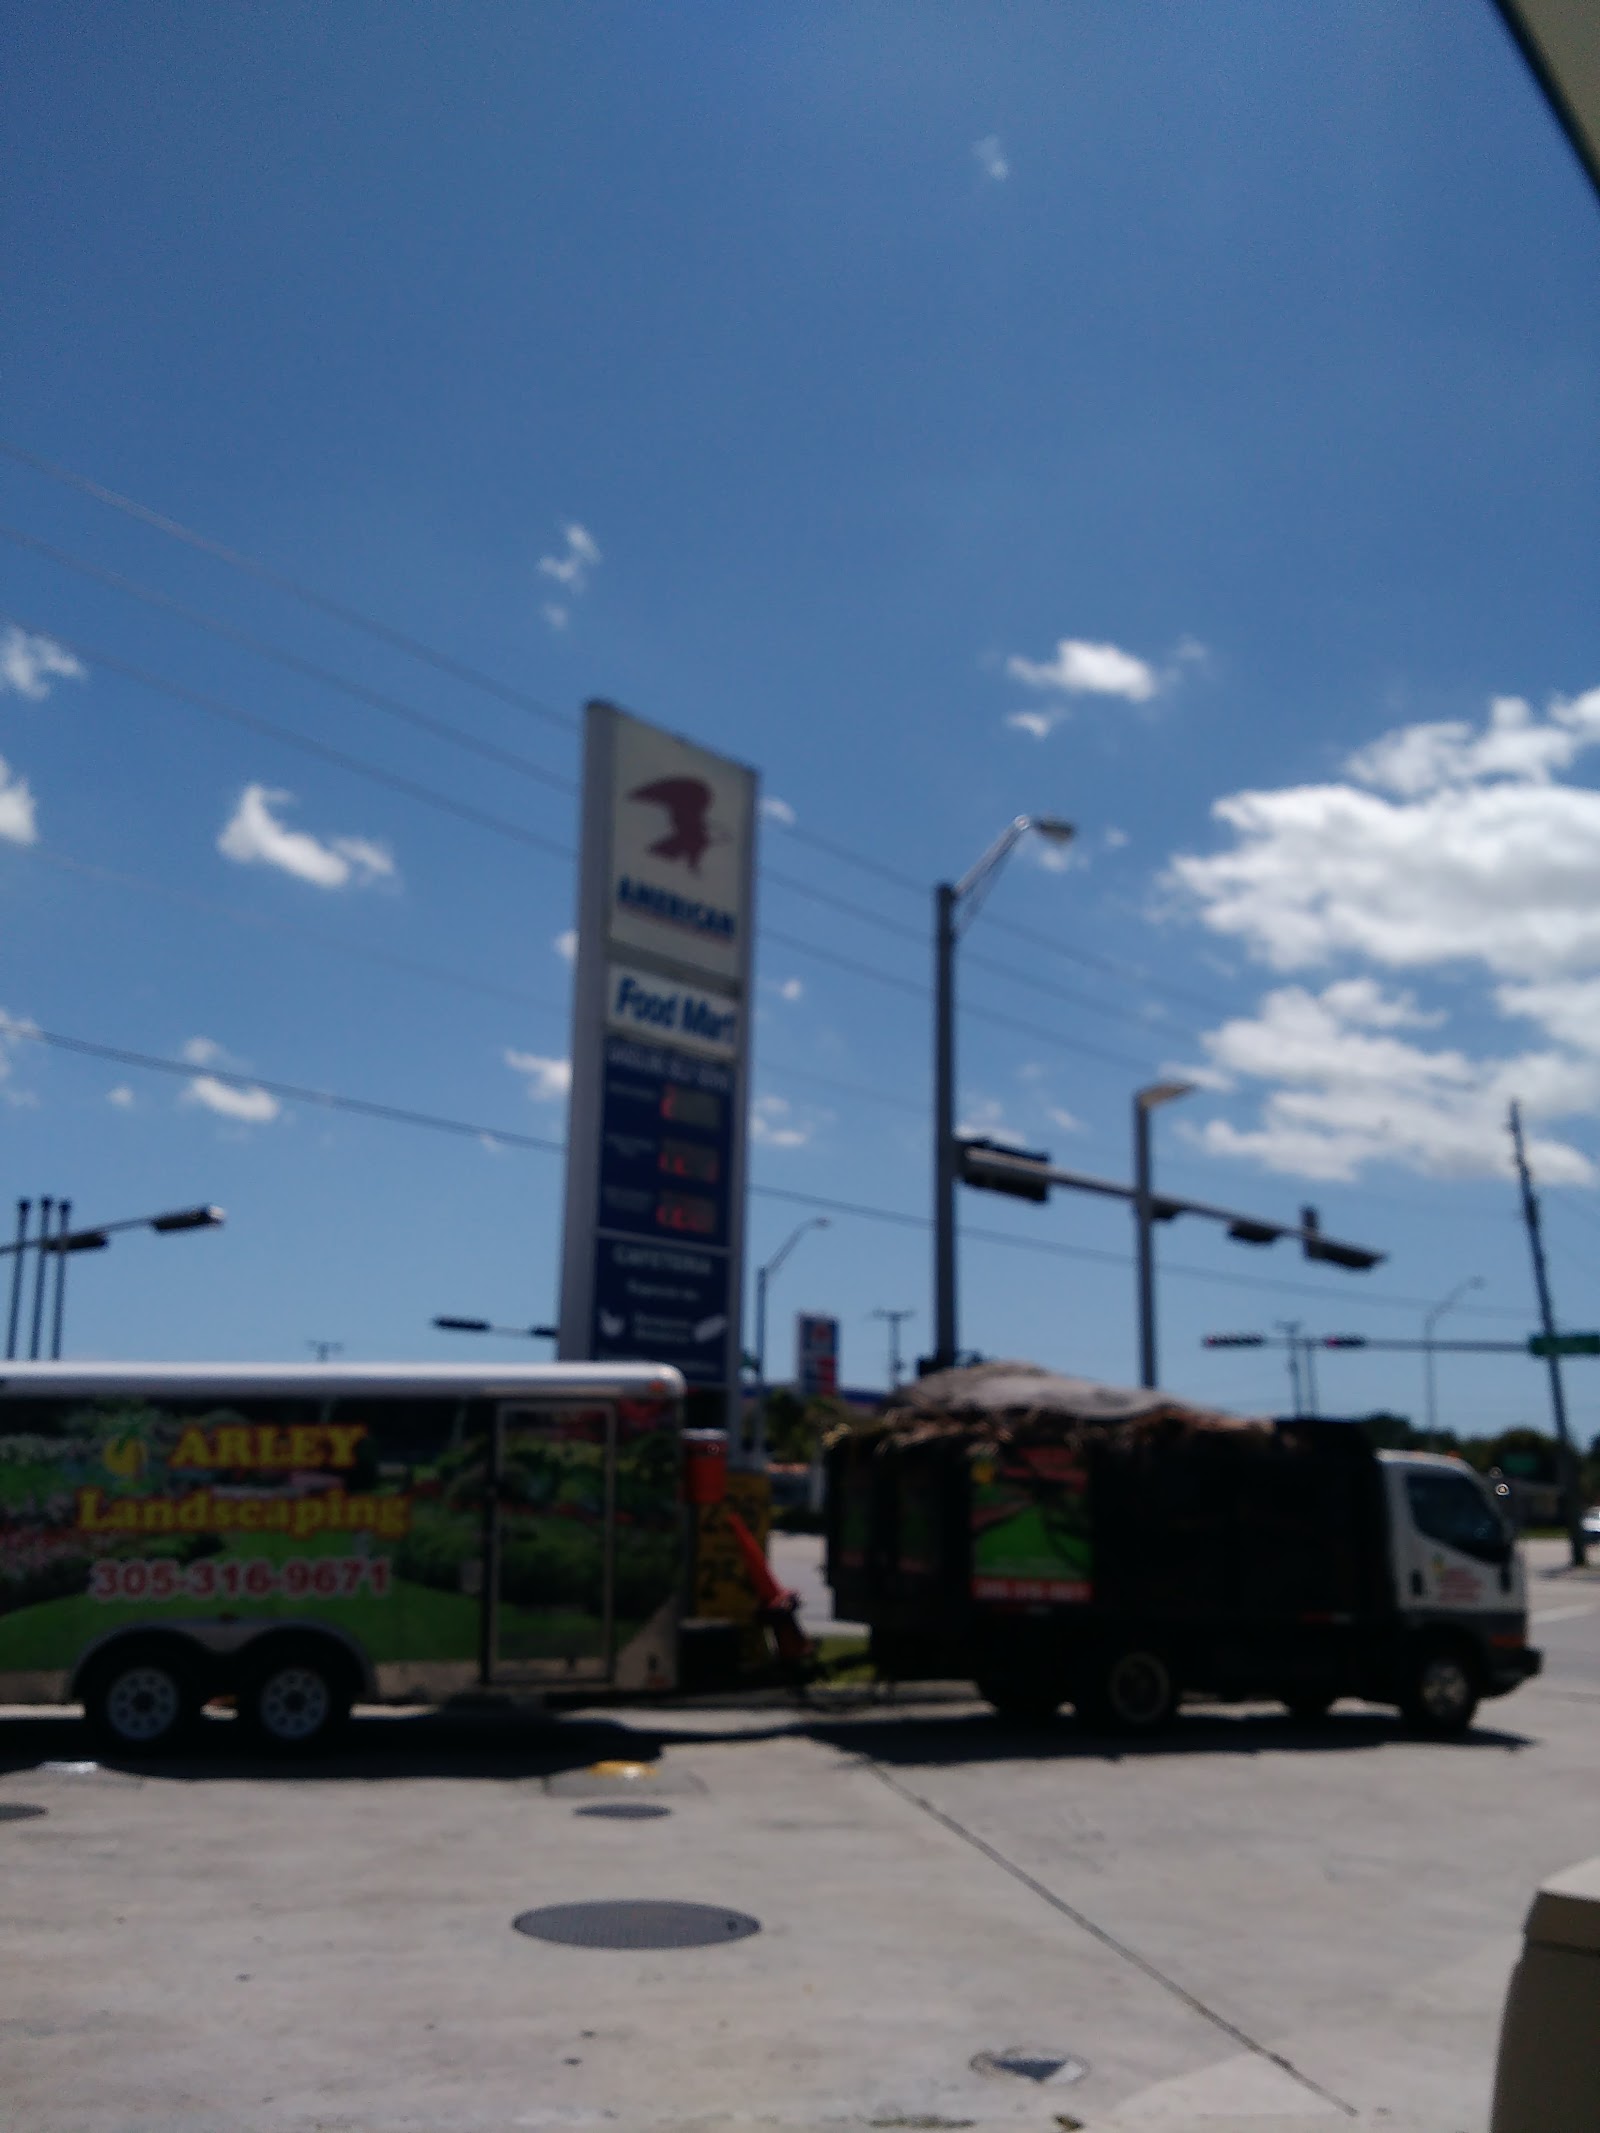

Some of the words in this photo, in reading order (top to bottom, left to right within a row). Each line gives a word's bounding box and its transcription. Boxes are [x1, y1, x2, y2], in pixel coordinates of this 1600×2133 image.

[615, 975, 678, 1027] Food
[167, 1422, 369, 1469] ARLEY
[75, 1485, 414, 1539] Landscaping
[88, 1558, 393, 1600] 305-316-9671
